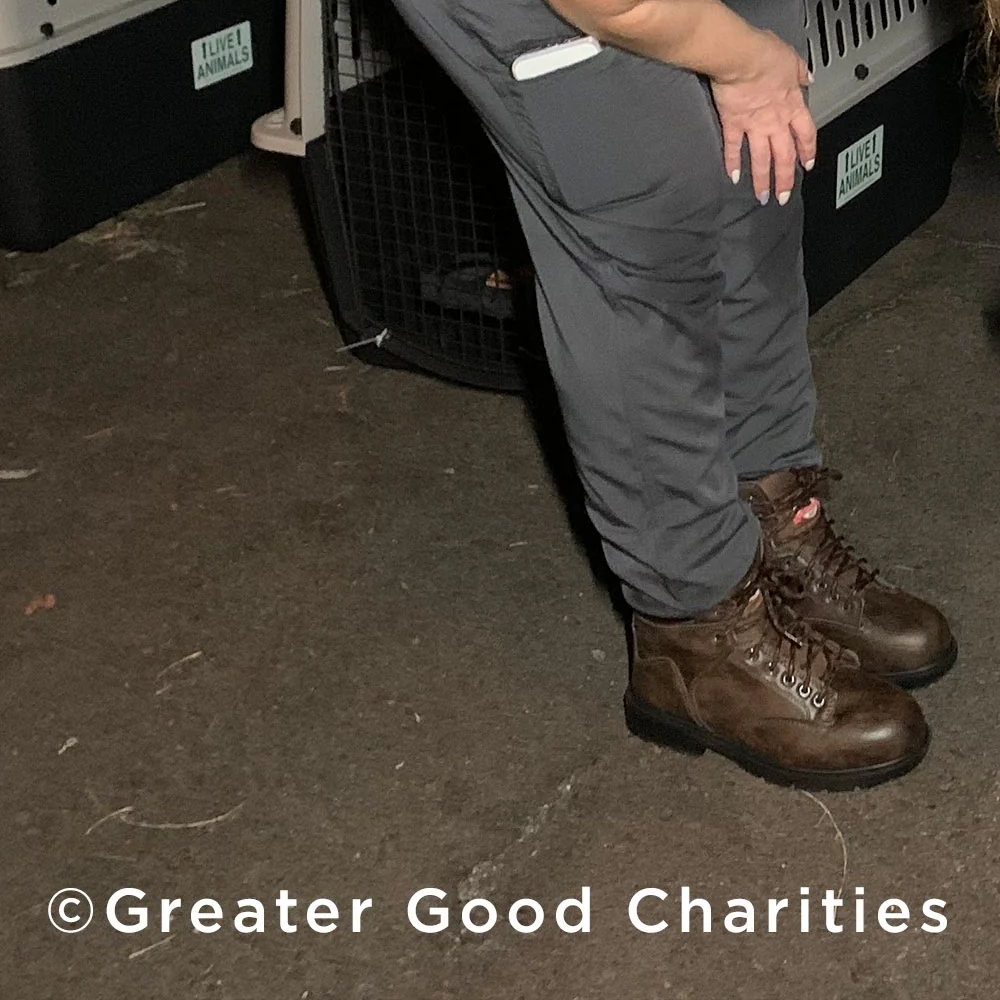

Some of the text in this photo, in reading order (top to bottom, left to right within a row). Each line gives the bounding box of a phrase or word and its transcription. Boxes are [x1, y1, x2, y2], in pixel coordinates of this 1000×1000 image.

[208, 32, 235, 56] LIVE
[198, 45, 249, 79] ANIMALS
[850, 139, 871, 169] LIVE
[839, 154, 880, 198] ANIMALS
